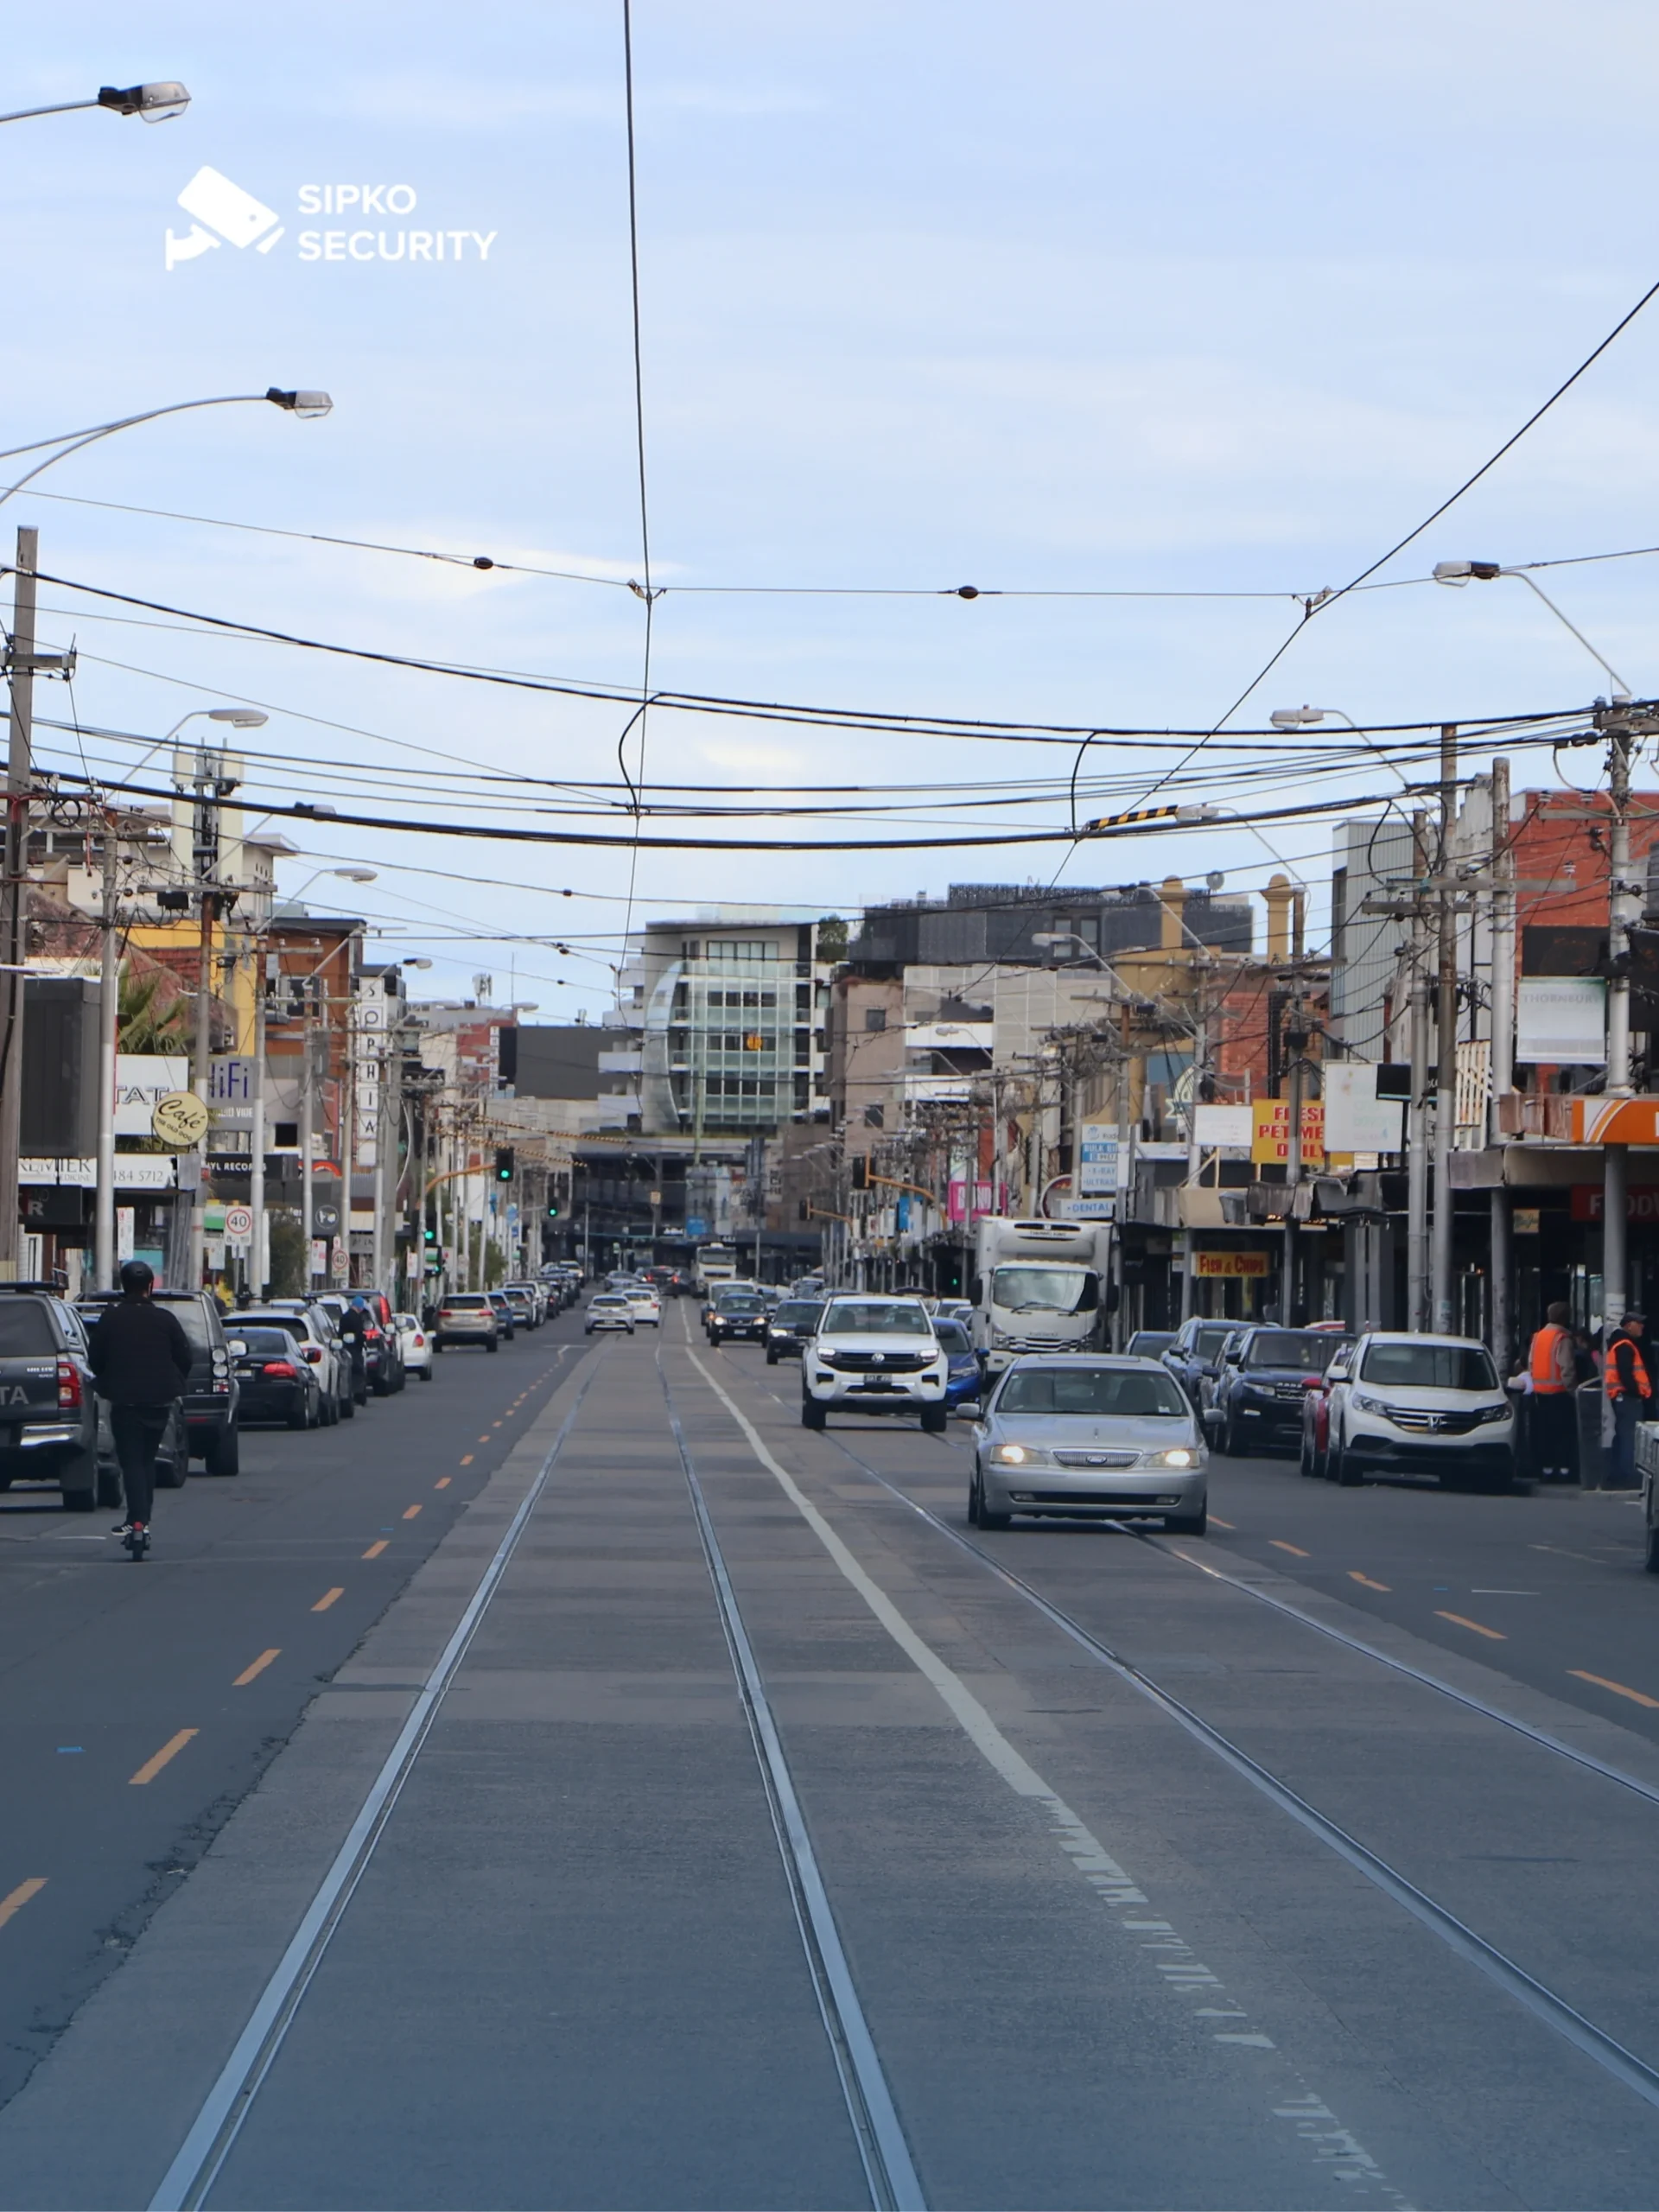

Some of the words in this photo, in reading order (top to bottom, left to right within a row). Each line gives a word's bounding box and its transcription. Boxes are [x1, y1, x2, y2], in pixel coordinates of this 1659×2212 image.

[158, 1099, 206, 1128] Café
[1277, 1143, 1325, 1158] DILY
[137, 1170, 163, 1182] 5712
[1072, 1203, 1109, 1212] DENTAL
[231, 1215, 247, 1227] 40
[335, 1255, 346, 1264] 40
